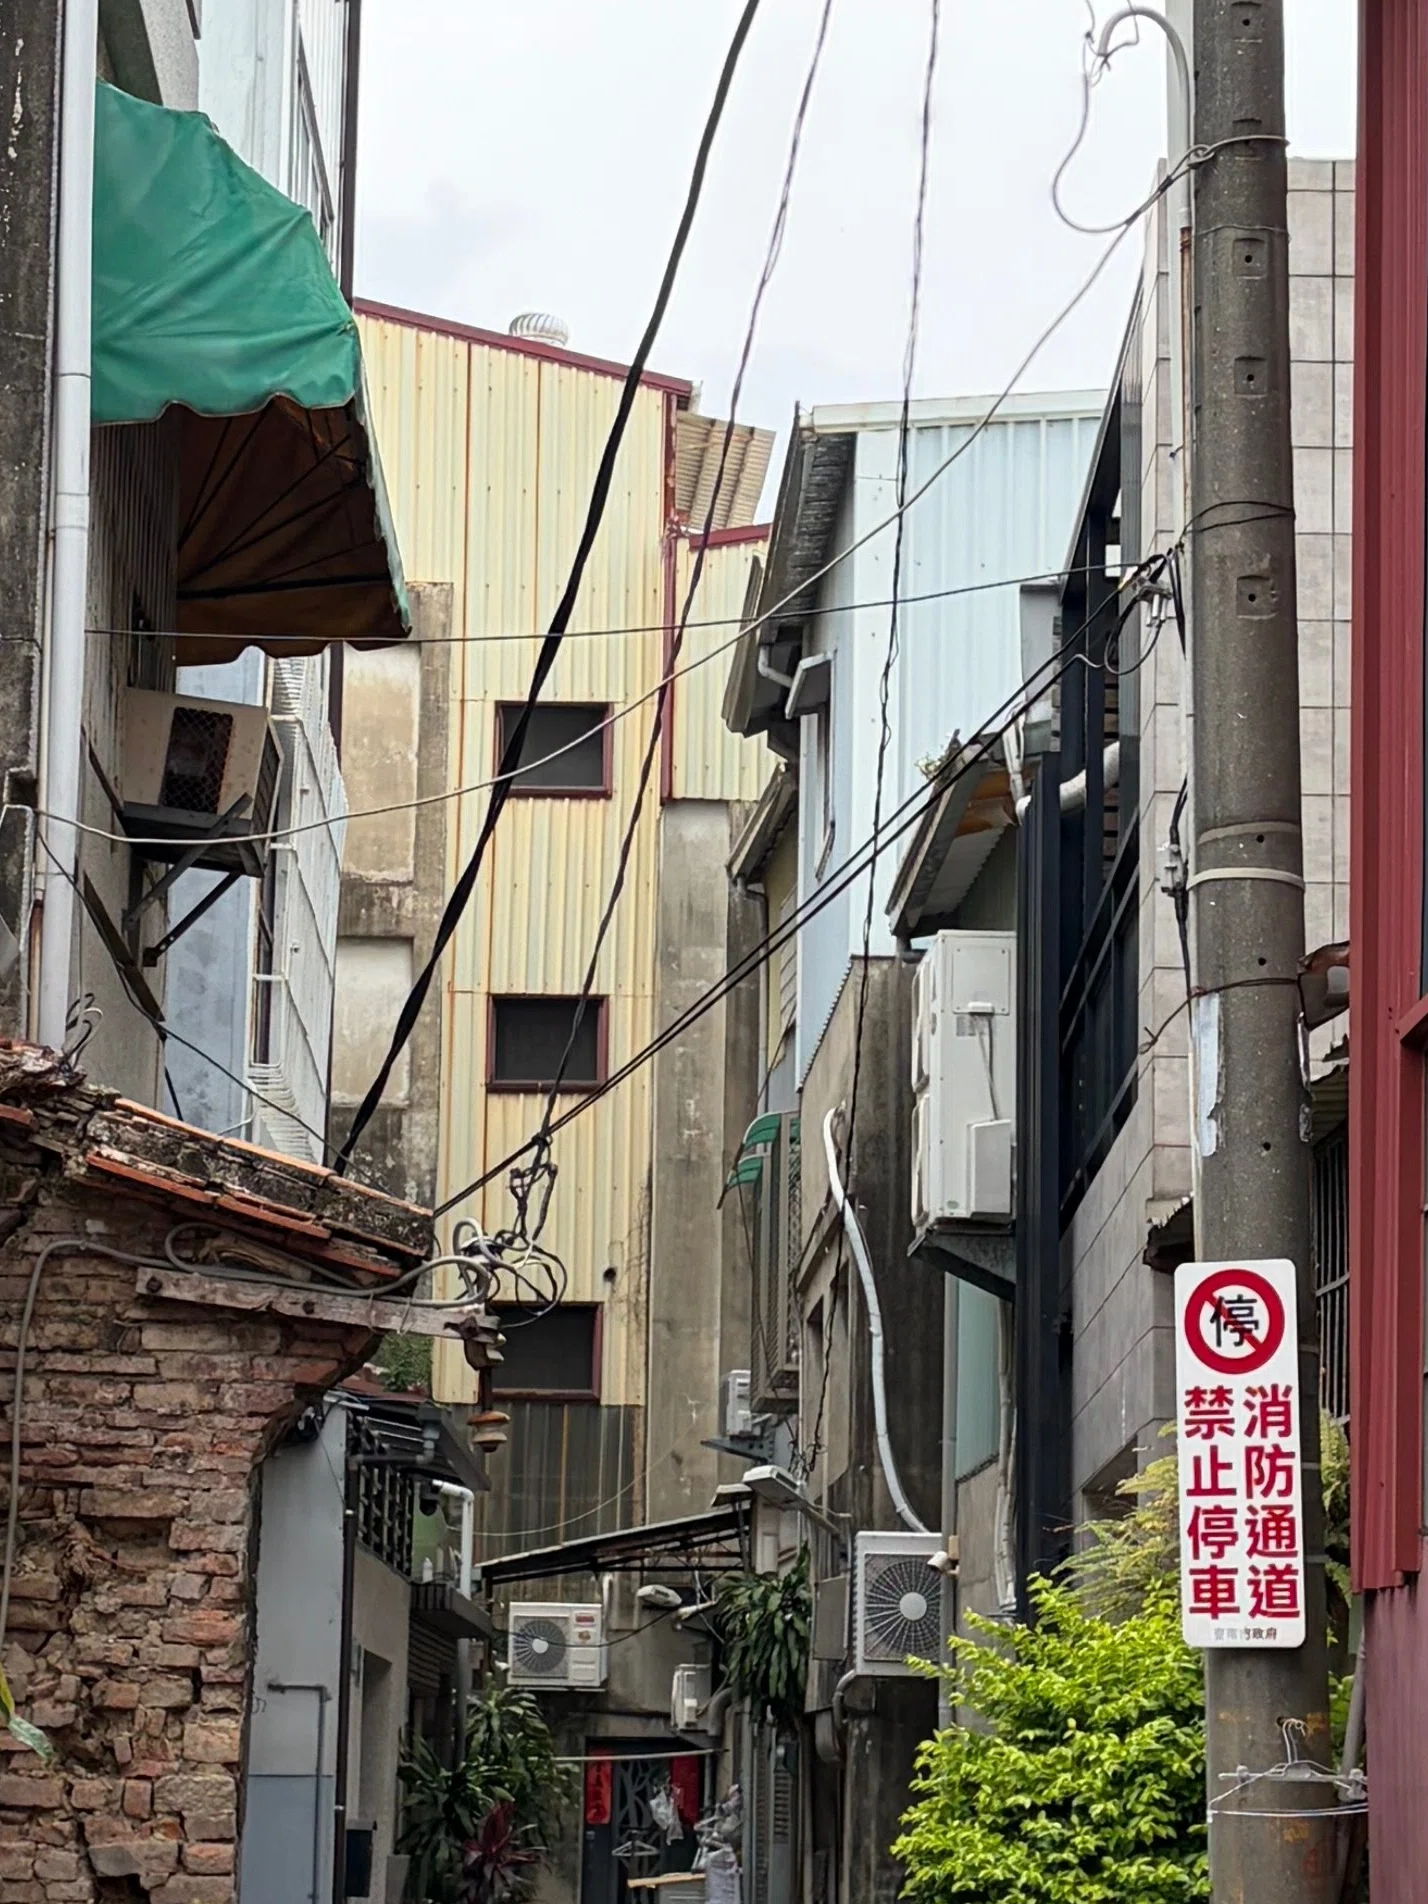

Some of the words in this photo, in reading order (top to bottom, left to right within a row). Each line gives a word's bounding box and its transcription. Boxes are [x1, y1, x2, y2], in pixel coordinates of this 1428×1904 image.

[1210, 1293, 1259, 1347] 停
[1184, 1385, 1240, 1620] 禁止停車
[1244, 1384, 1300, 1620] 消防通道
